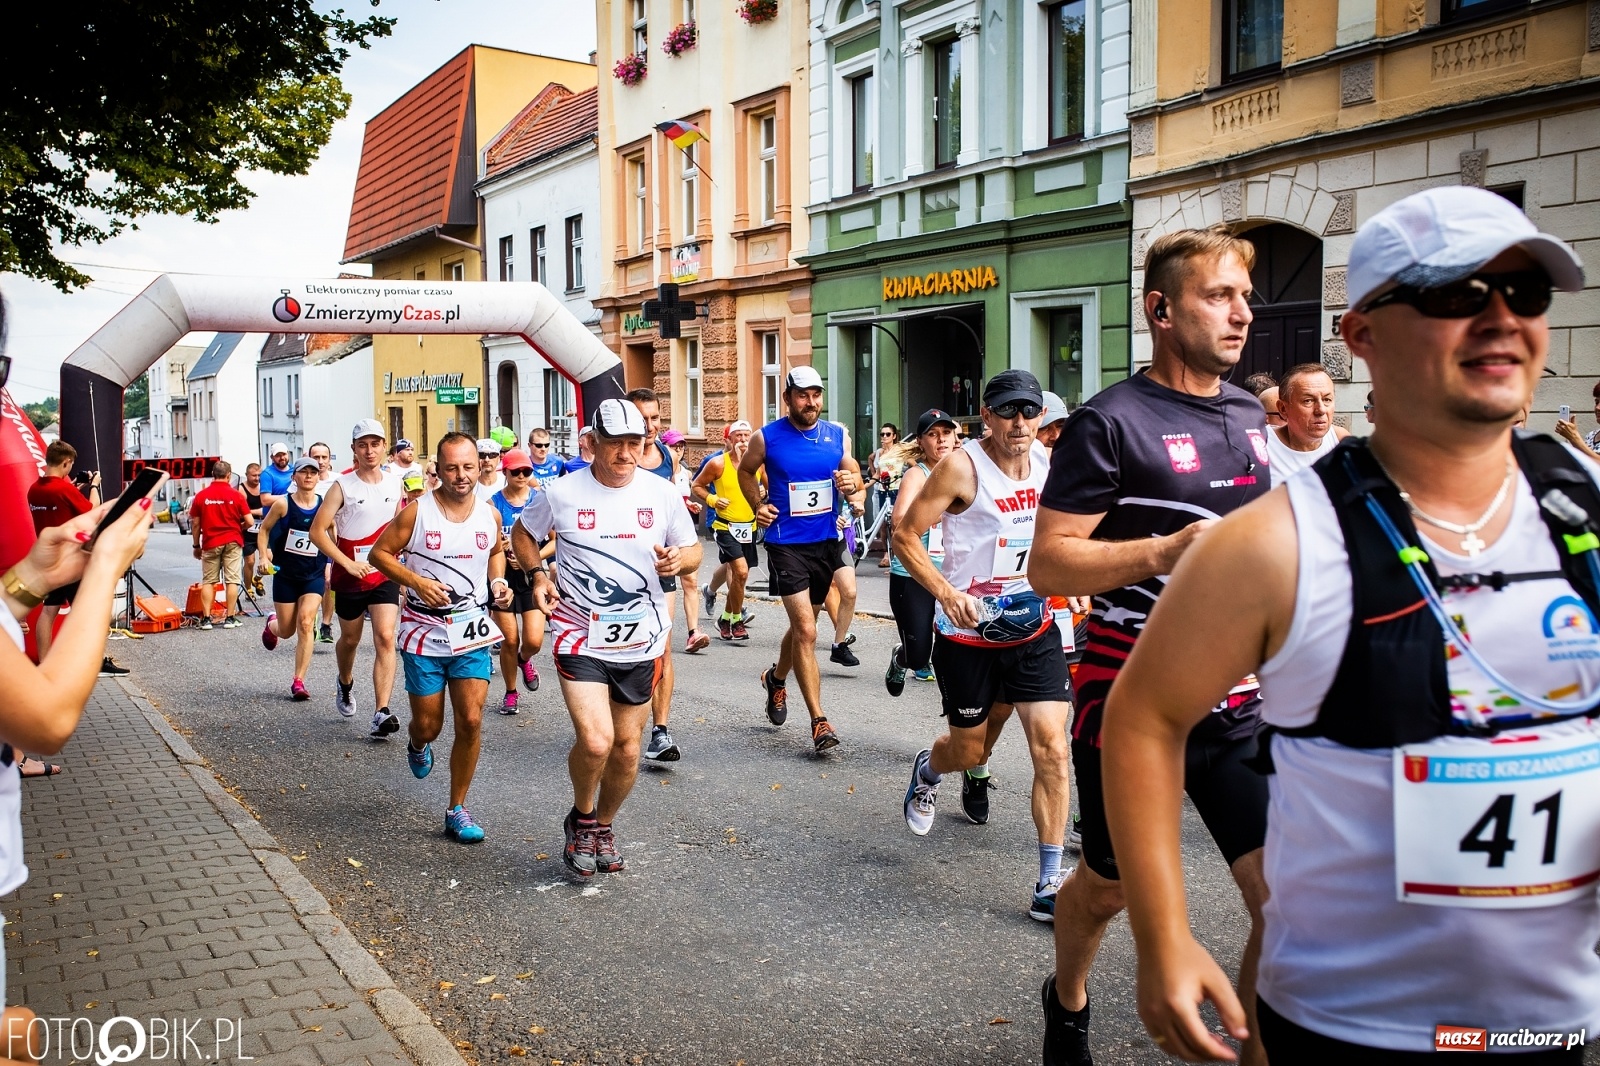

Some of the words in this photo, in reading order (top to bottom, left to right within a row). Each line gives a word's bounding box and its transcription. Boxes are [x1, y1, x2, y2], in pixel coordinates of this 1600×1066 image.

[305, 284, 381, 297] Elektroniczny
[383, 286, 421, 297] pomiar
[423, 288, 453, 296] czasu
[883, 265, 998, 301] KWIACIARNIA
[304, 303, 460, 324] ZmierzymyCzas.pl
[1331, 314, 1342, 336] 5
[394, 376, 411, 393] BANK
[1161, 432, 1192, 440] POLSKA
[807, 491, 819, 508] 3
[994, 488, 1040, 513] RAFA
[1012, 515, 1034, 524] GRUPA
[734, 528, 748, 539] 26
[295, 538, 311, 550] 61
[1003, 607, 1030, 617] Reebok
[463, 617, 490, 641] 46
[604, 622, 640, 643] 37
[1433, 762, 1442, 778] I
[1445, 762, 1490, 778] BIEG
[1459, 788, 1563, 868] 41
